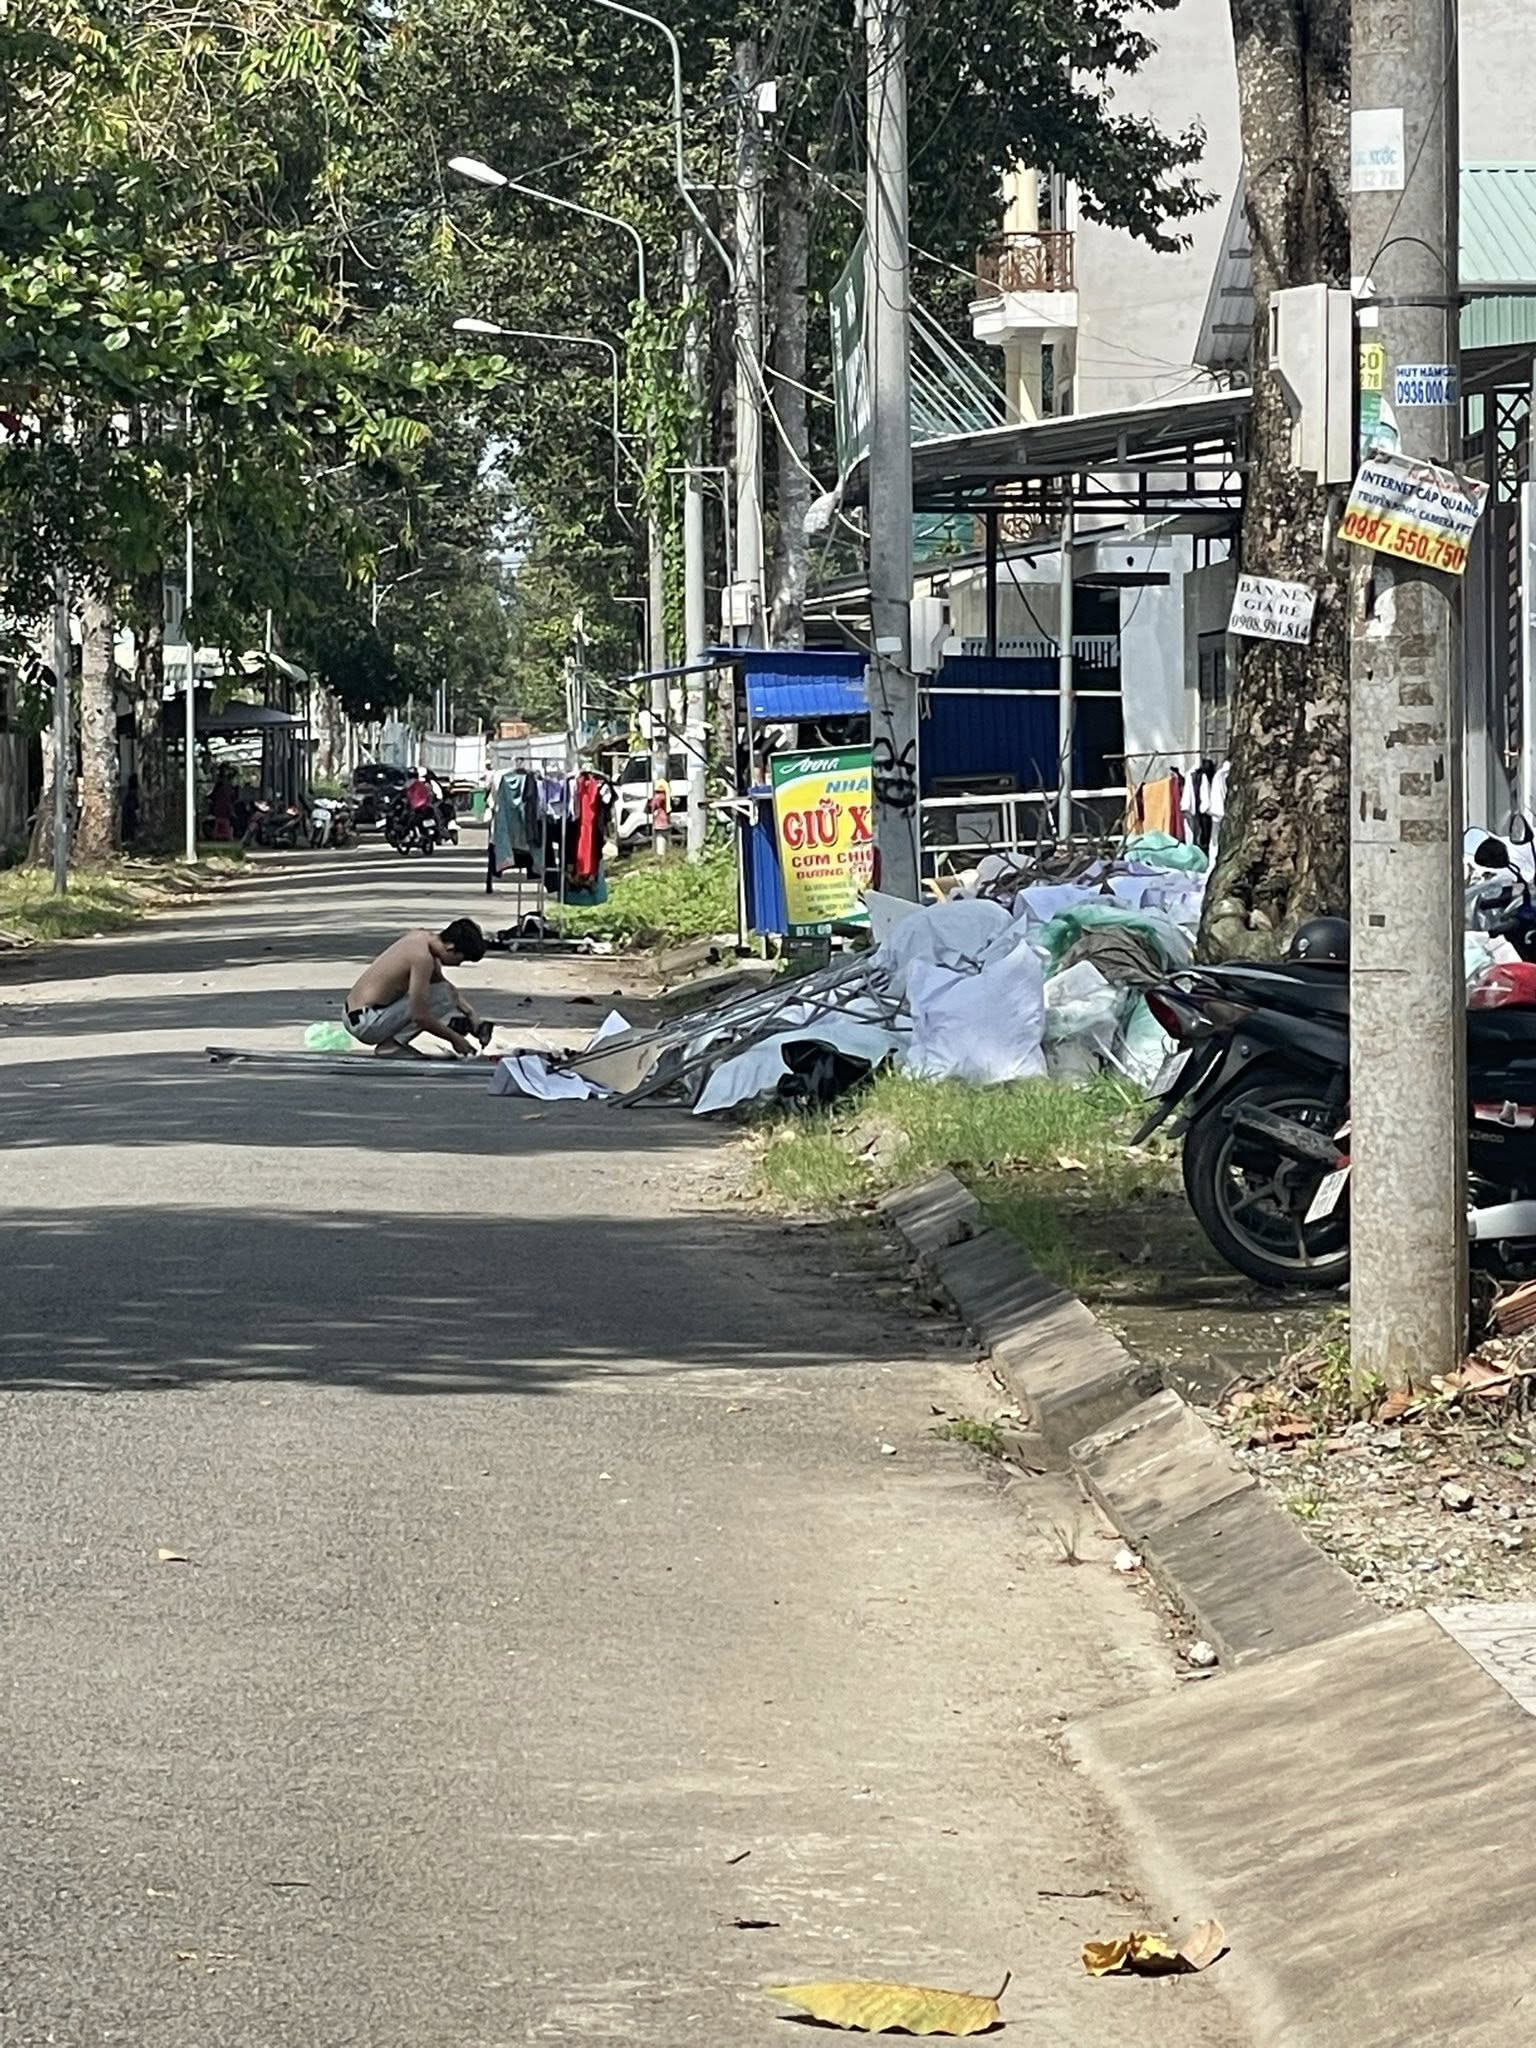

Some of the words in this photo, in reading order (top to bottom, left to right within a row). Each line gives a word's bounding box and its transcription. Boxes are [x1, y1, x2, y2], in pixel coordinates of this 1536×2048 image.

[1361, 470, 1416, 497] INTERNET
[1441, 496, 1479, 518] QUANG
[1344, 511, 1466, 571] 0987.550.750
